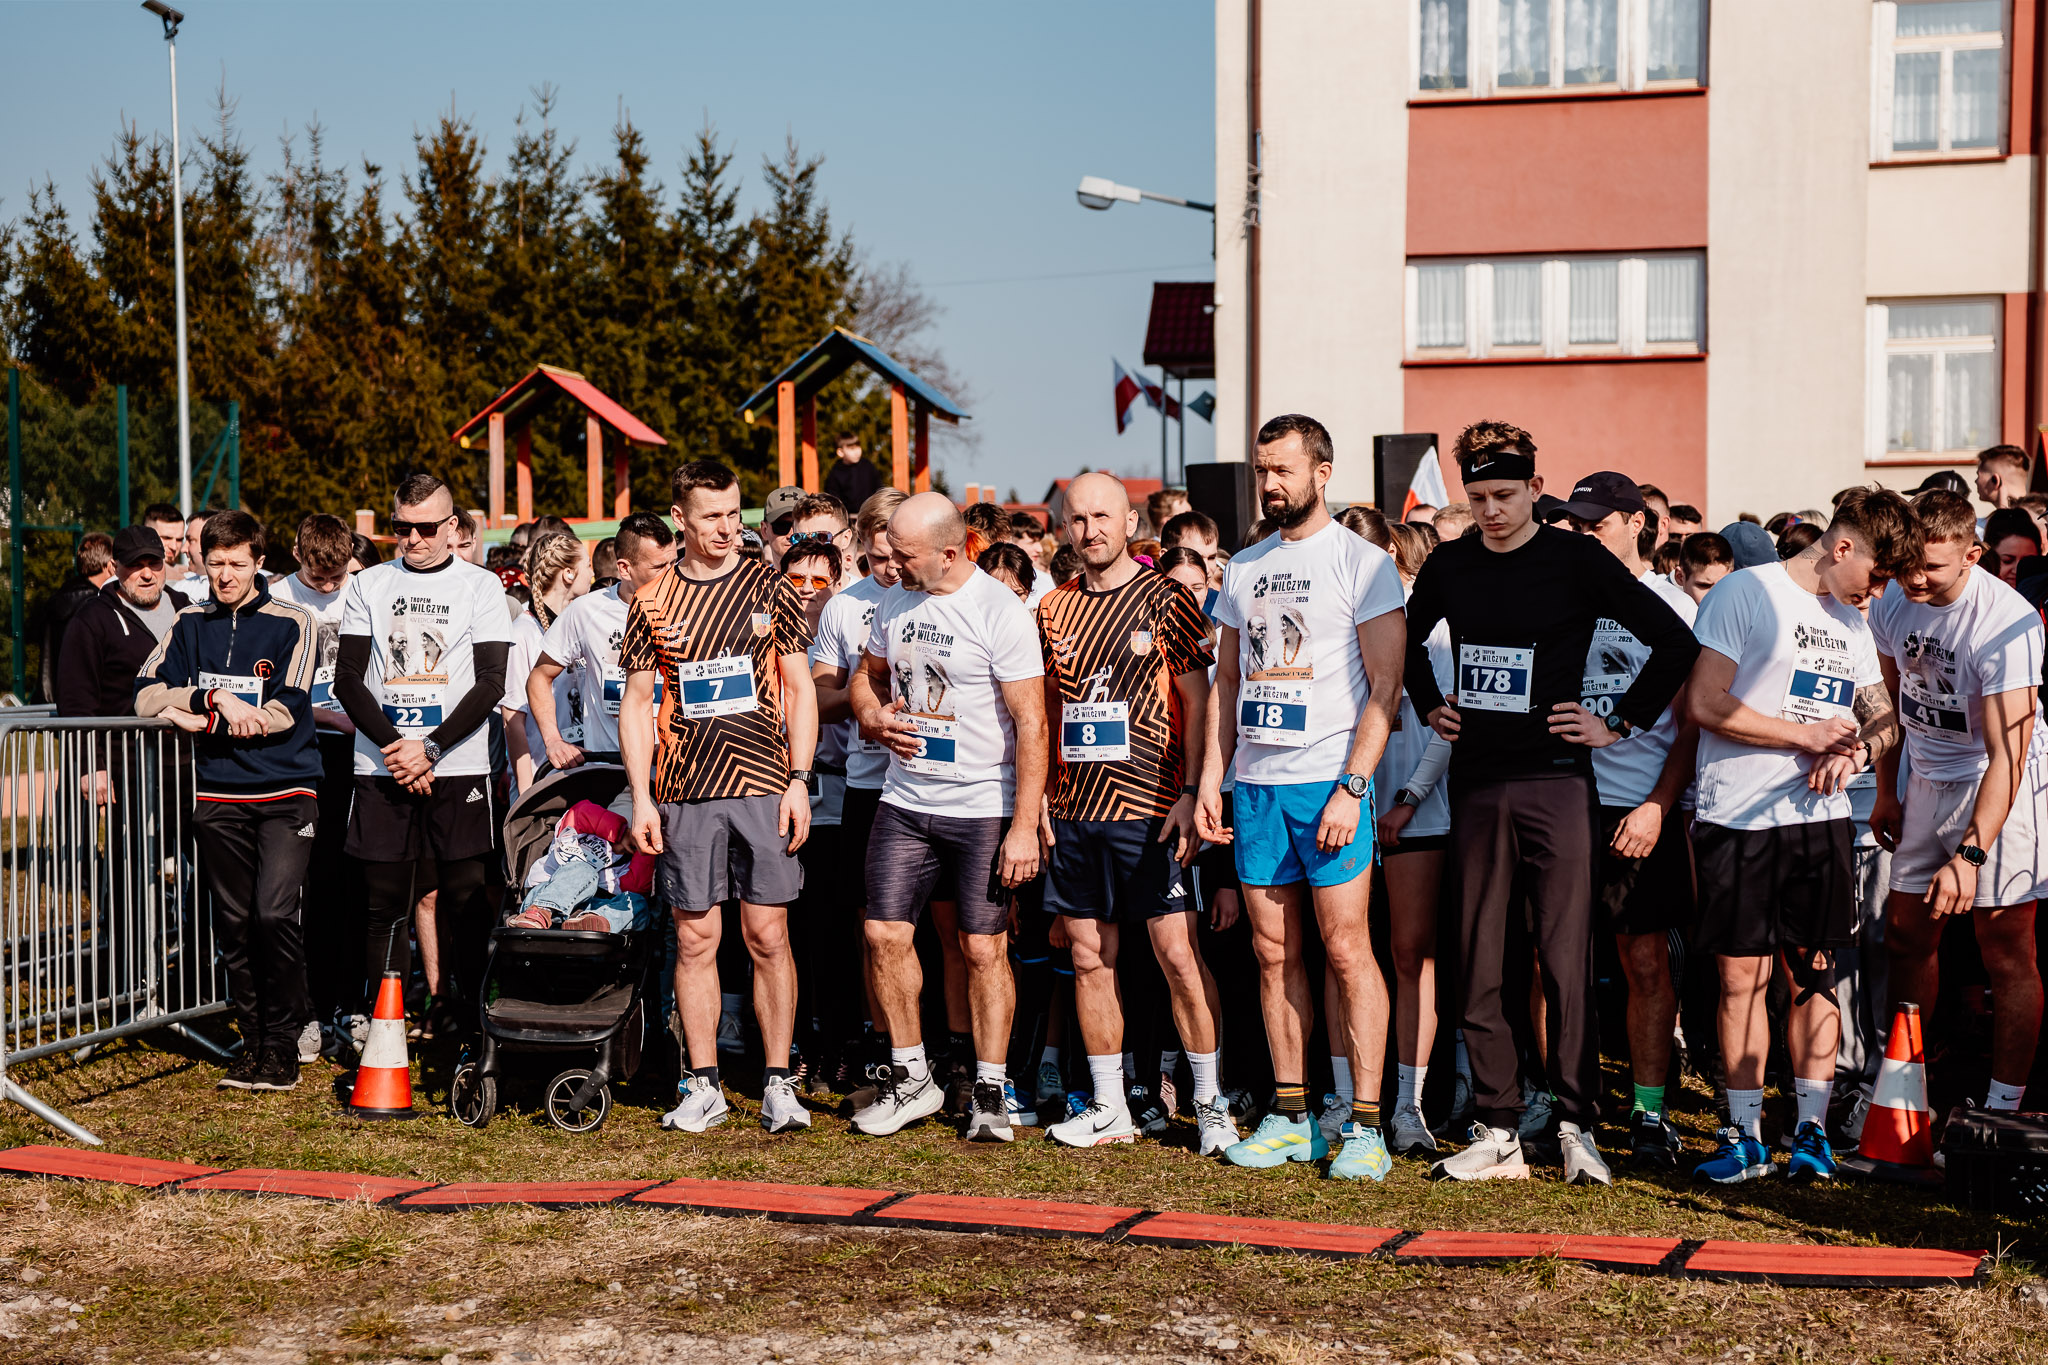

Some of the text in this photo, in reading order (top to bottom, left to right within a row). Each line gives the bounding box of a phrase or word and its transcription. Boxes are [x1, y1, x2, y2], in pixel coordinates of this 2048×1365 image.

[1271, 580, 1311, 592] WILCZYM
[410, 603, 450, 614] WILCZYM
[919, 622, 936, 631] TROPEM
[918, 630, 954, 646] WILCZYM
[1810, 634, 1848, 652] WILCZYM
[1482, 655, 1508, 663] WILCZYM
[1923, 644, 1955, 662] WILCZYM
[707, 666, 733, 675] WILCZYM
[1828, 664, 1850, 675] WILCZYM
[1471, 668, 1511, 692] 178
[709, 680, 724, 700] 7
[1263, 691, 1288, 699] WILCZYM
[1812, 676, 1843, 703] 51
[1581, 696, 1614, 717] 90
[1920, 695, 1945, 706] WILCZYM
[396, 708, 423, 726] 22
[1257, 704, 1283, 727] 18
[1916, 705, 1941, 727] 41
[1082, 724, 1096, 745] 8
